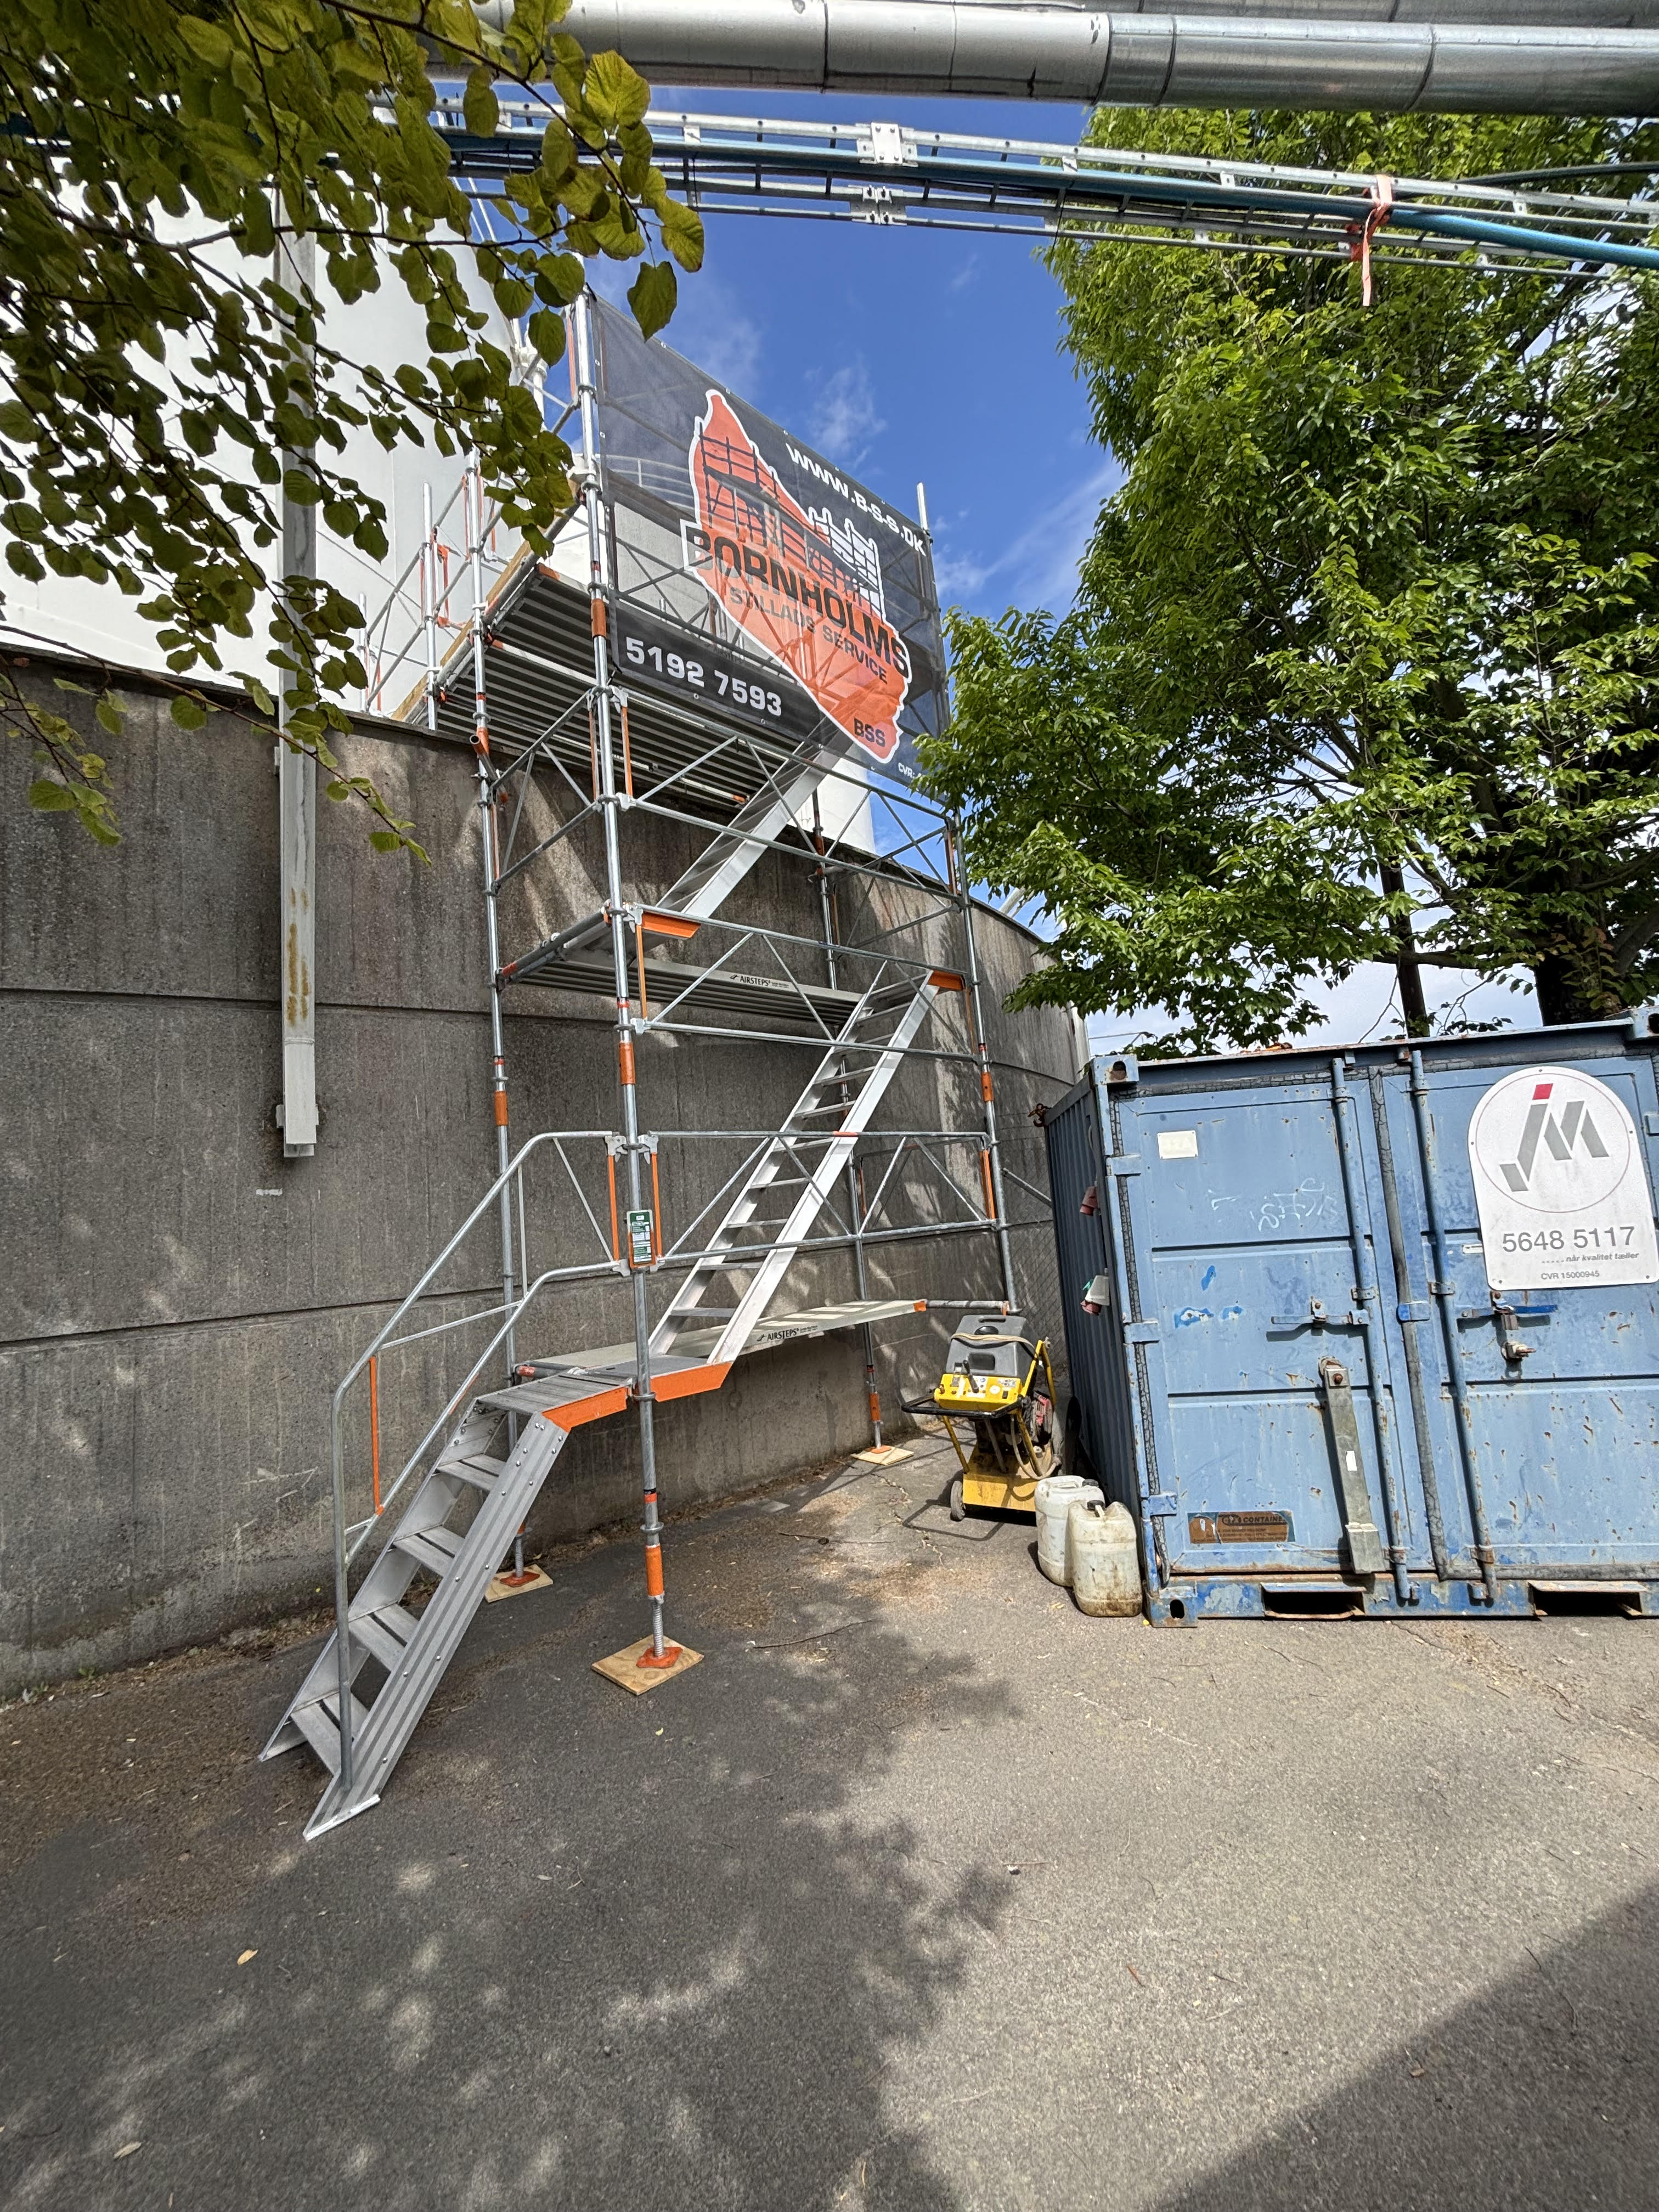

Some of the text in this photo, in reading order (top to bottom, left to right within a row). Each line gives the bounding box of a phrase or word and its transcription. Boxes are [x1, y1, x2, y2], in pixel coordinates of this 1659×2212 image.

[685, 528, 909, 679] BORNHOLMS
[730, 586, 888, 685] STILLADS SERVICE
[625, 636, 782, 716] 5192 7593
[853, 716, 887, 748] BSS
[1502, 1226, 1635, 1252] 5648 5117
[1561, 1269, 1600, 1279] 15000945
[1582, 1254, 1613, 1262] kvalitet
